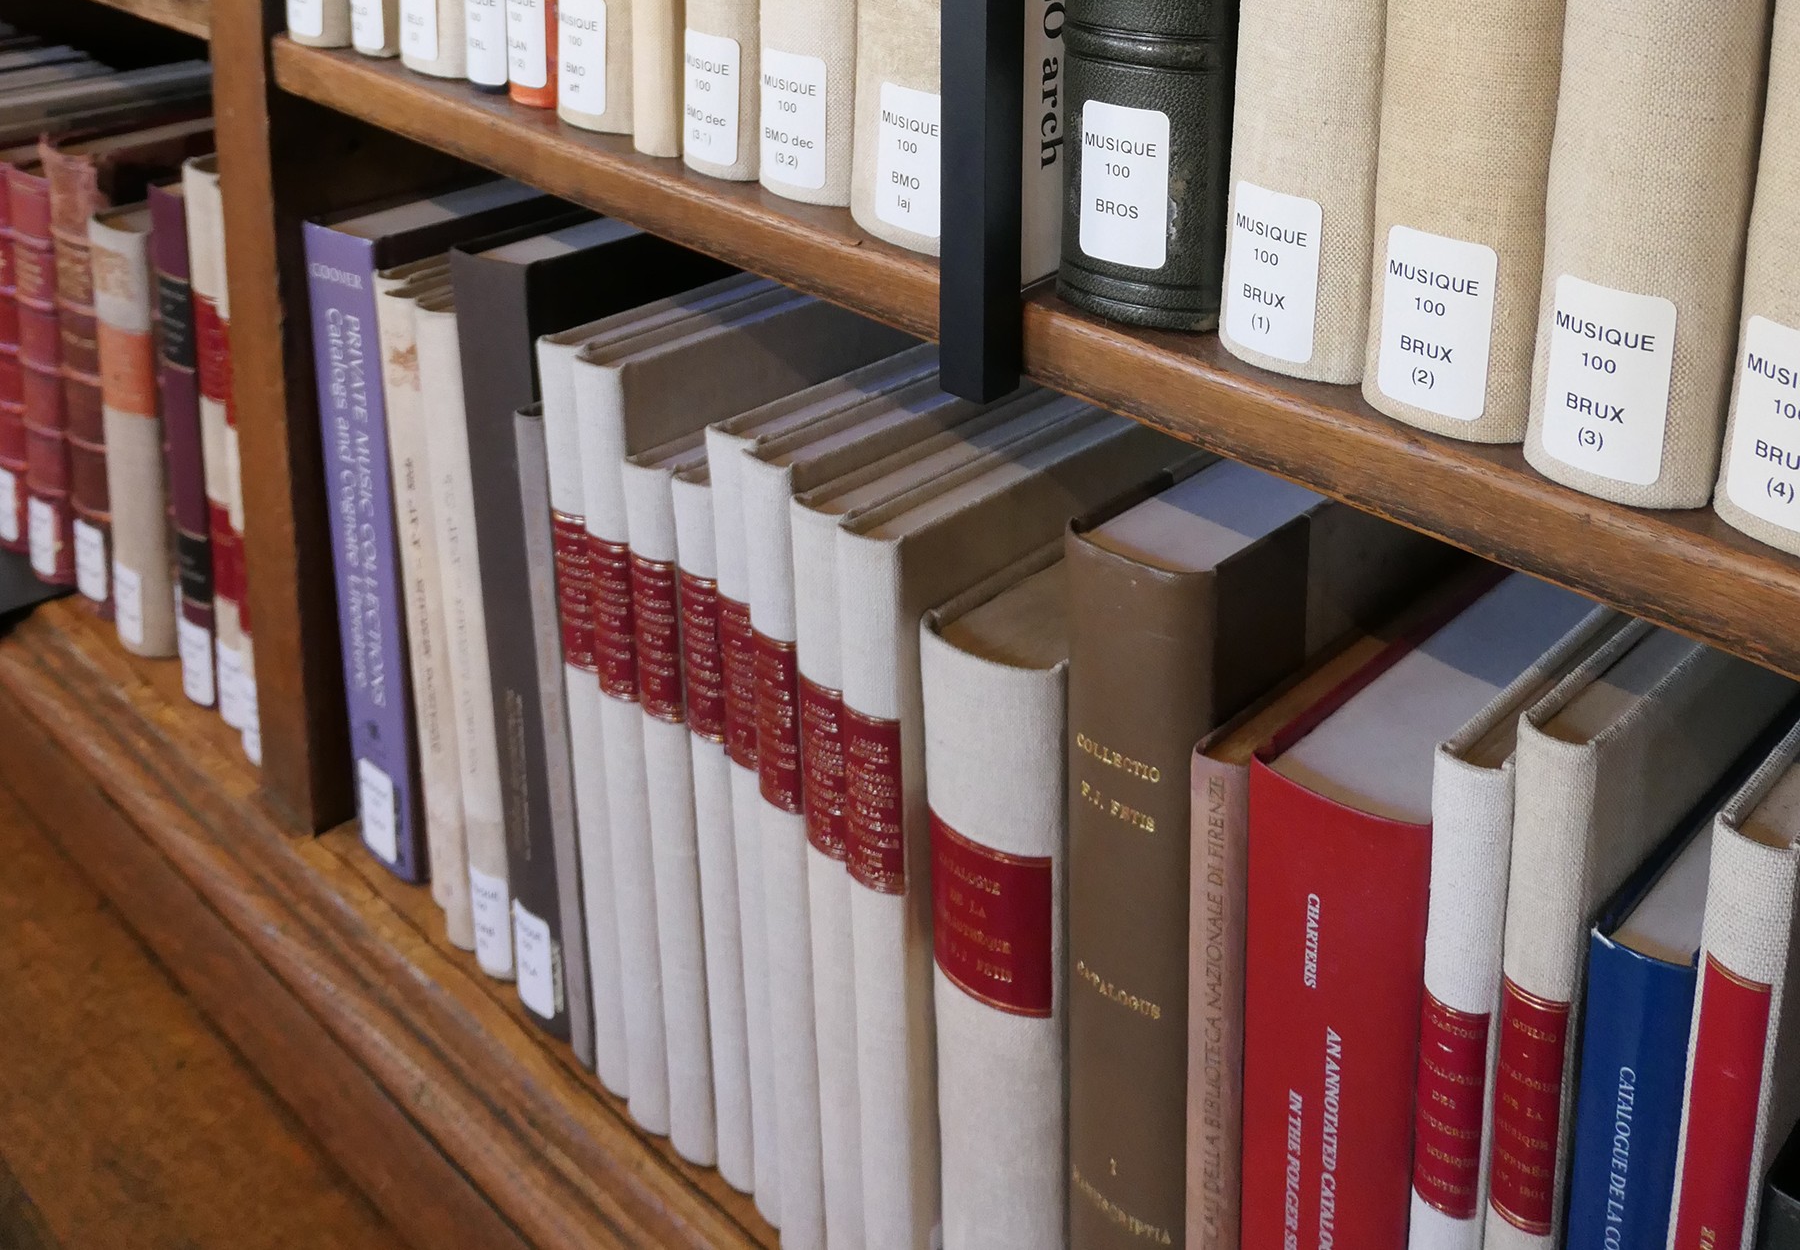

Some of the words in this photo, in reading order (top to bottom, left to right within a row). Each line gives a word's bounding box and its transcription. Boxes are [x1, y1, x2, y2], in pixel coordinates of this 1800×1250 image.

[560, 12, 598, 32] MUSIQUE
[568, 35, 583, 47] 100
[565, 61, 586, 77] BMO
[686, 53, 730, 76] MUSIQUE
[694, 78, 711, 92] 100
[764, 74, 817, 97] MUSIQUE
[686, 104, 704, 122] BMO
[705, 112, 727, 127] dec
[777, 100, 798, 114] 100
[1040, 55, 1065, 171] arch
[882, 109, 940, 137] MUSIQUE
[764, 127, 789, 144] BMO
[791, 135, 814, 150] dec
[897, 138, 918, 154] 100
[1084, 131, 1157, 158] MUSIQUE
[775, 152, 799, 170] (3.2)
[1104, 162, 1131, 180] 100
[891, 171, 921, 191] BMO
[1095, 197, 1140, 220] BROS
[1235, 211, 1308, 248] MUSIQUE
[1253, 247, 1280, 267] 100
[1389, 258, 1480, 297] MUSIQUE
[1242, 282, 1286, 311] BRUX
[1414, 296, 1446, 318] 100
[1250, 315, 1272, 336] (1)
[1555, 309, 1657, 353] MUSIQUE
[325, 308, 349, 410] Catalogs
[1400, 333, 1454, 364] BRUX
[344, 314, 369, 423] PRIVATE
[1581, 352, 1618, 376] 100
[1411, 366, 1436, 391] (2)
[1565, 391, 1626, 425] BRUX
[1774, 398, 1800, 421] 10
[333, 416, 356, 464] and
[1577, 426, 1605, 452] (3)
[355, 430, 375, 517] MUSIC
[1766, 476, 1795, 505] (4)
[360, 522, 386, 708] COLLECTIONS
[1076, 732, 1160, 784] COLLECTIO
[1207, 777, 1225, 860] FIRENZE
[1207, 863, 1224, 888] DI
[1206, 893, 1223, 1011] NAZIONALE
[1304, 893, 1320, 989] CHARTERIS
[1326, 1026, 1342, 1059] AN
[1204, 1015, 1222, 1131] BIBLIOTECA
[1289, 1088, 1303, 1112] IN
[1322, 1060, 1341, 1172] ANNOTATED
[1612, 1066, 1637, 1173] CATALOGUE
[1288, 1114, 1302, 1154] THE
[1284, 1151, 1301, 1232] FOLGER
[1609, 1171, 1627, 1201] DE
[1606, 1199, 1625, 1224] LA
[1604, 1225, 1622, 1250] CO
